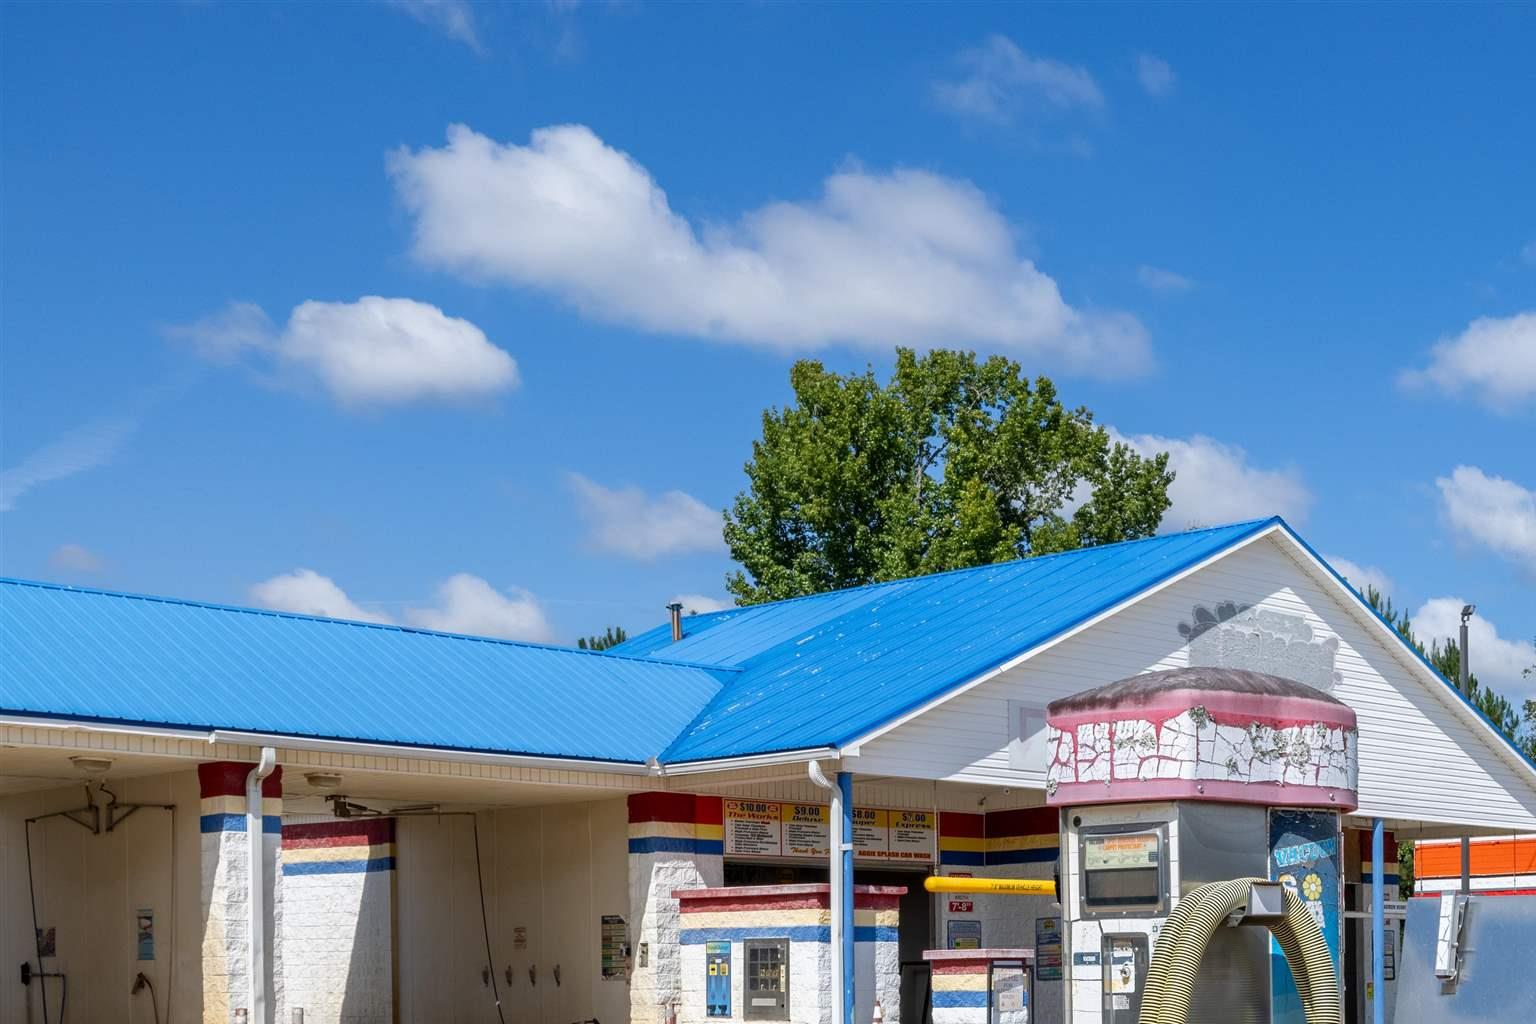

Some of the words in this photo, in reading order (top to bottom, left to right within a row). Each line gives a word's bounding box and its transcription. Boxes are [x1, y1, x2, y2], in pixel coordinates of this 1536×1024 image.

[740, 802, 767, 812] $10.00
[794, 806, 820, 816] $9.00
[727, 811, 746, 819] The
[747, 812, 779, 821] Works
[877, 850, 900, 858] SPLASH
[901, 851, 913, 859] CAR
